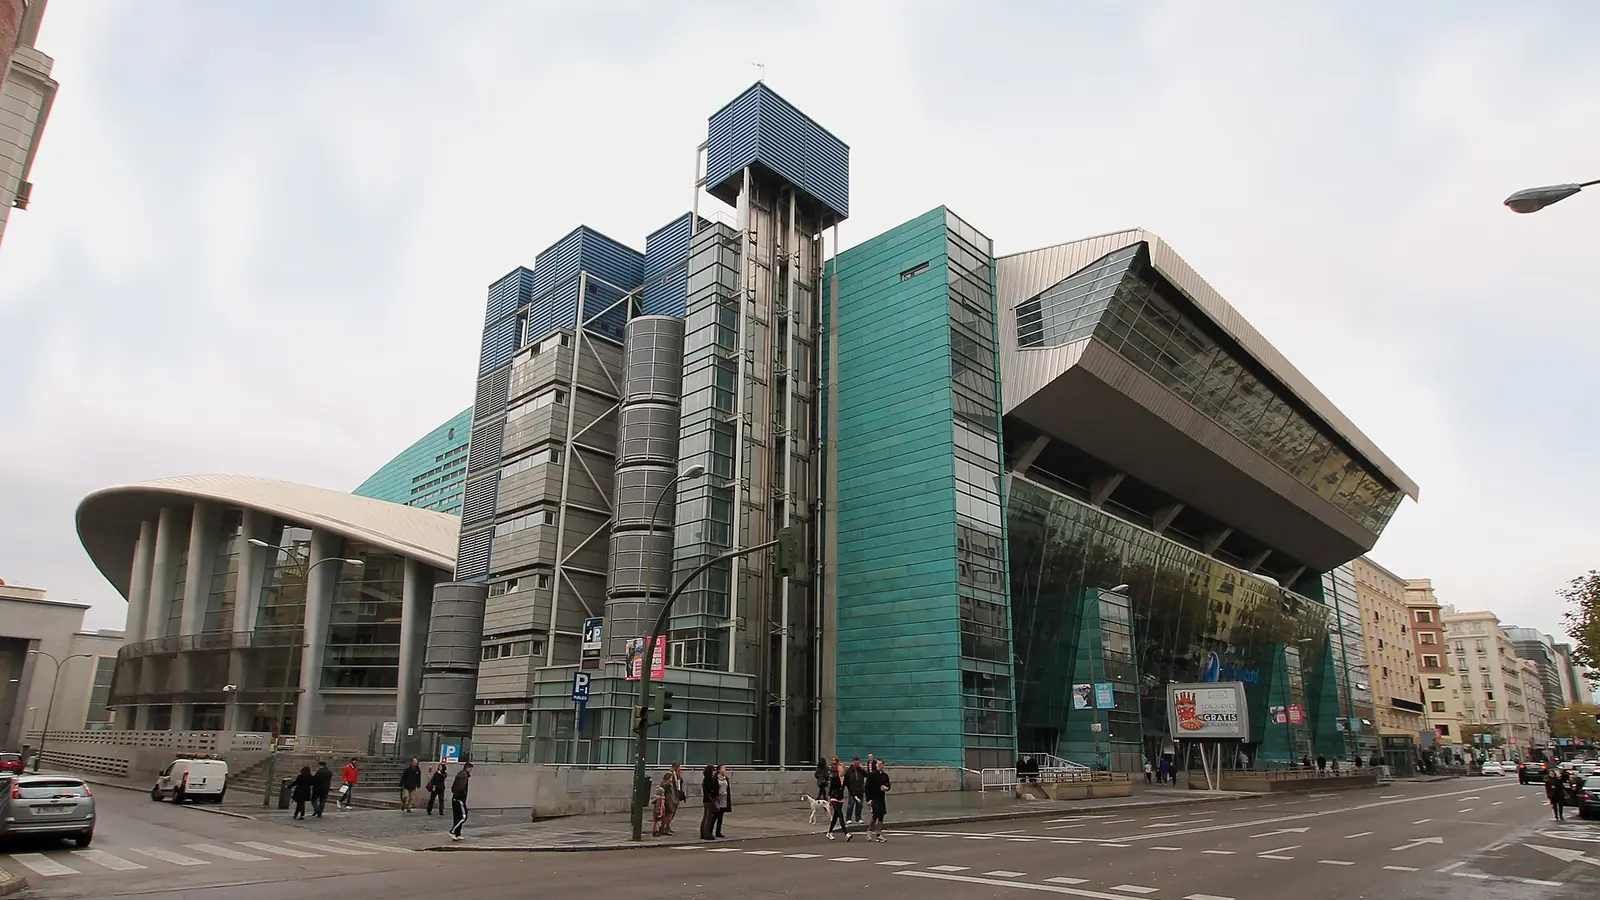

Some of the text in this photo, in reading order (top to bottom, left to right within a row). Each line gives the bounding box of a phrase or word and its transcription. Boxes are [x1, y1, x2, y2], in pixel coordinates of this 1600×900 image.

[594, 628, 601, 642] P
[575, 674, 589, 693] P
[446, 745, 456, 757] P
